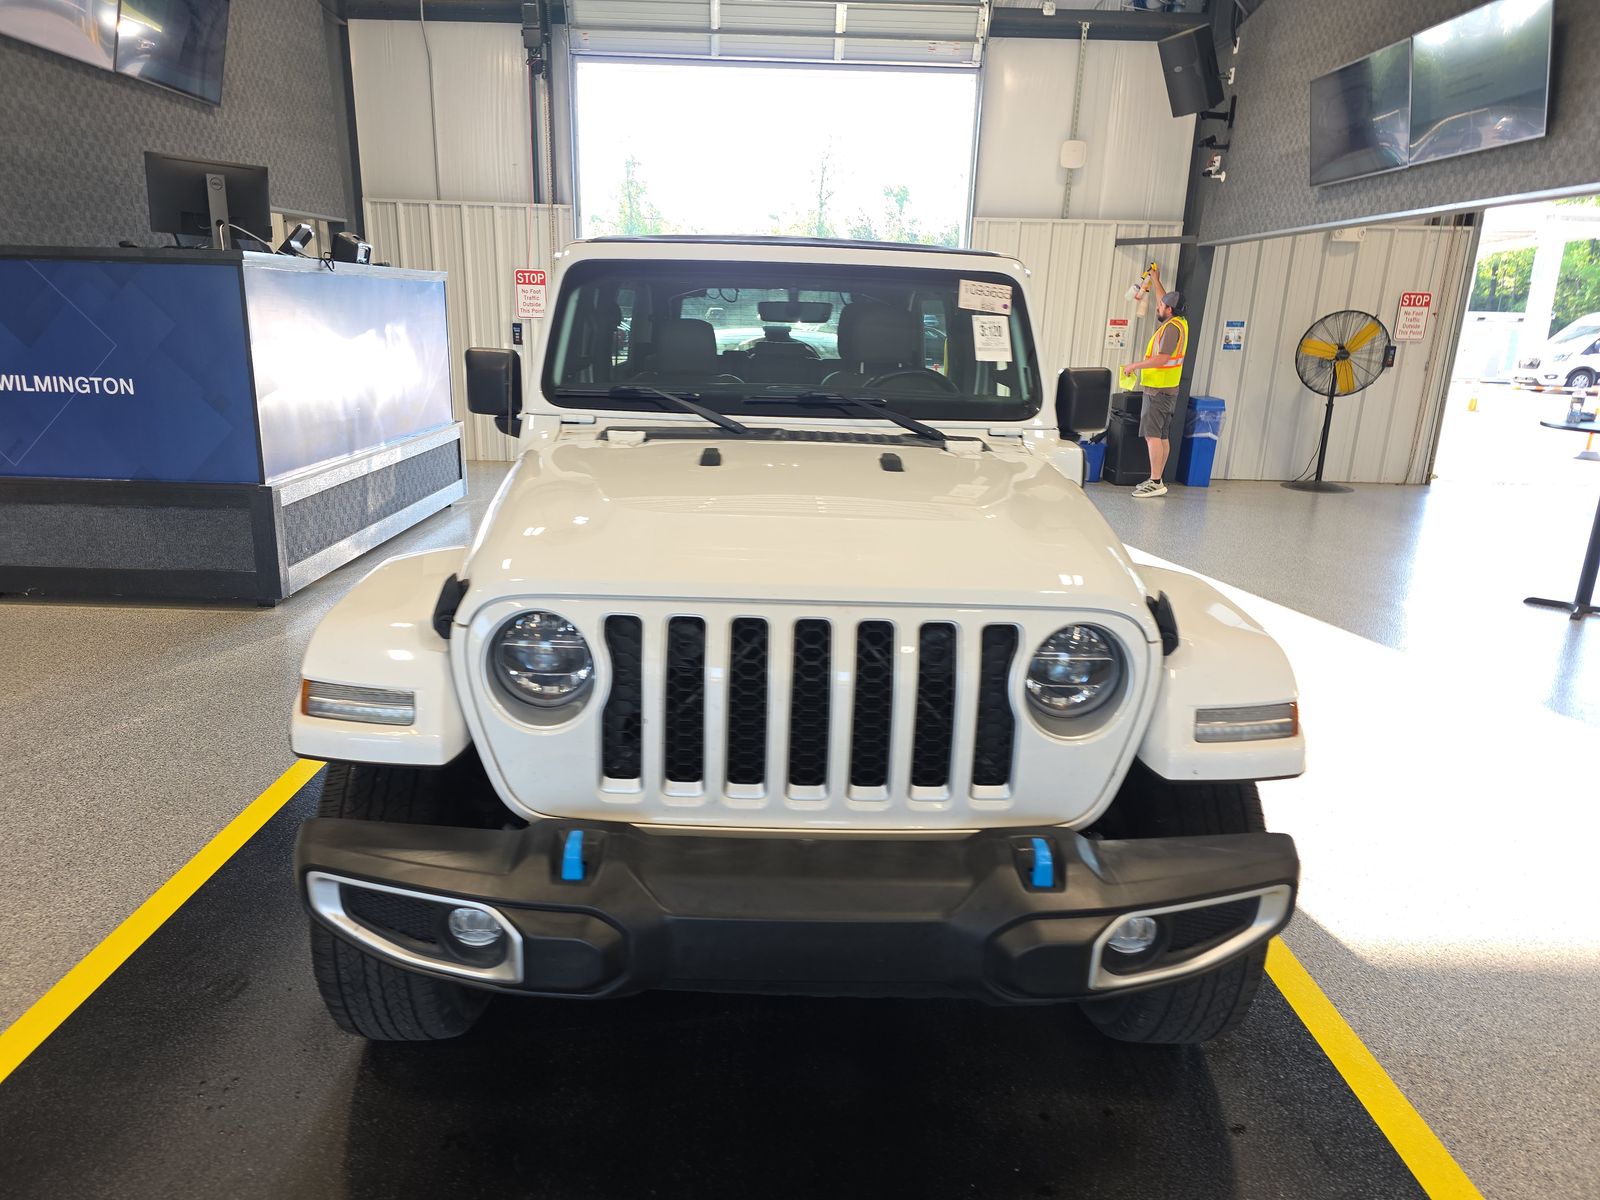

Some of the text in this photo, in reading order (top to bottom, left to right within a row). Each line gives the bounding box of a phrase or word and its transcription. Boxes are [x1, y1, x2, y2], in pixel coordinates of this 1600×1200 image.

[517, 272, 545, 284] STOP
[1402, 294, 1430, 306] STOP
[0, 374, 135, 395] WILMINGTON
